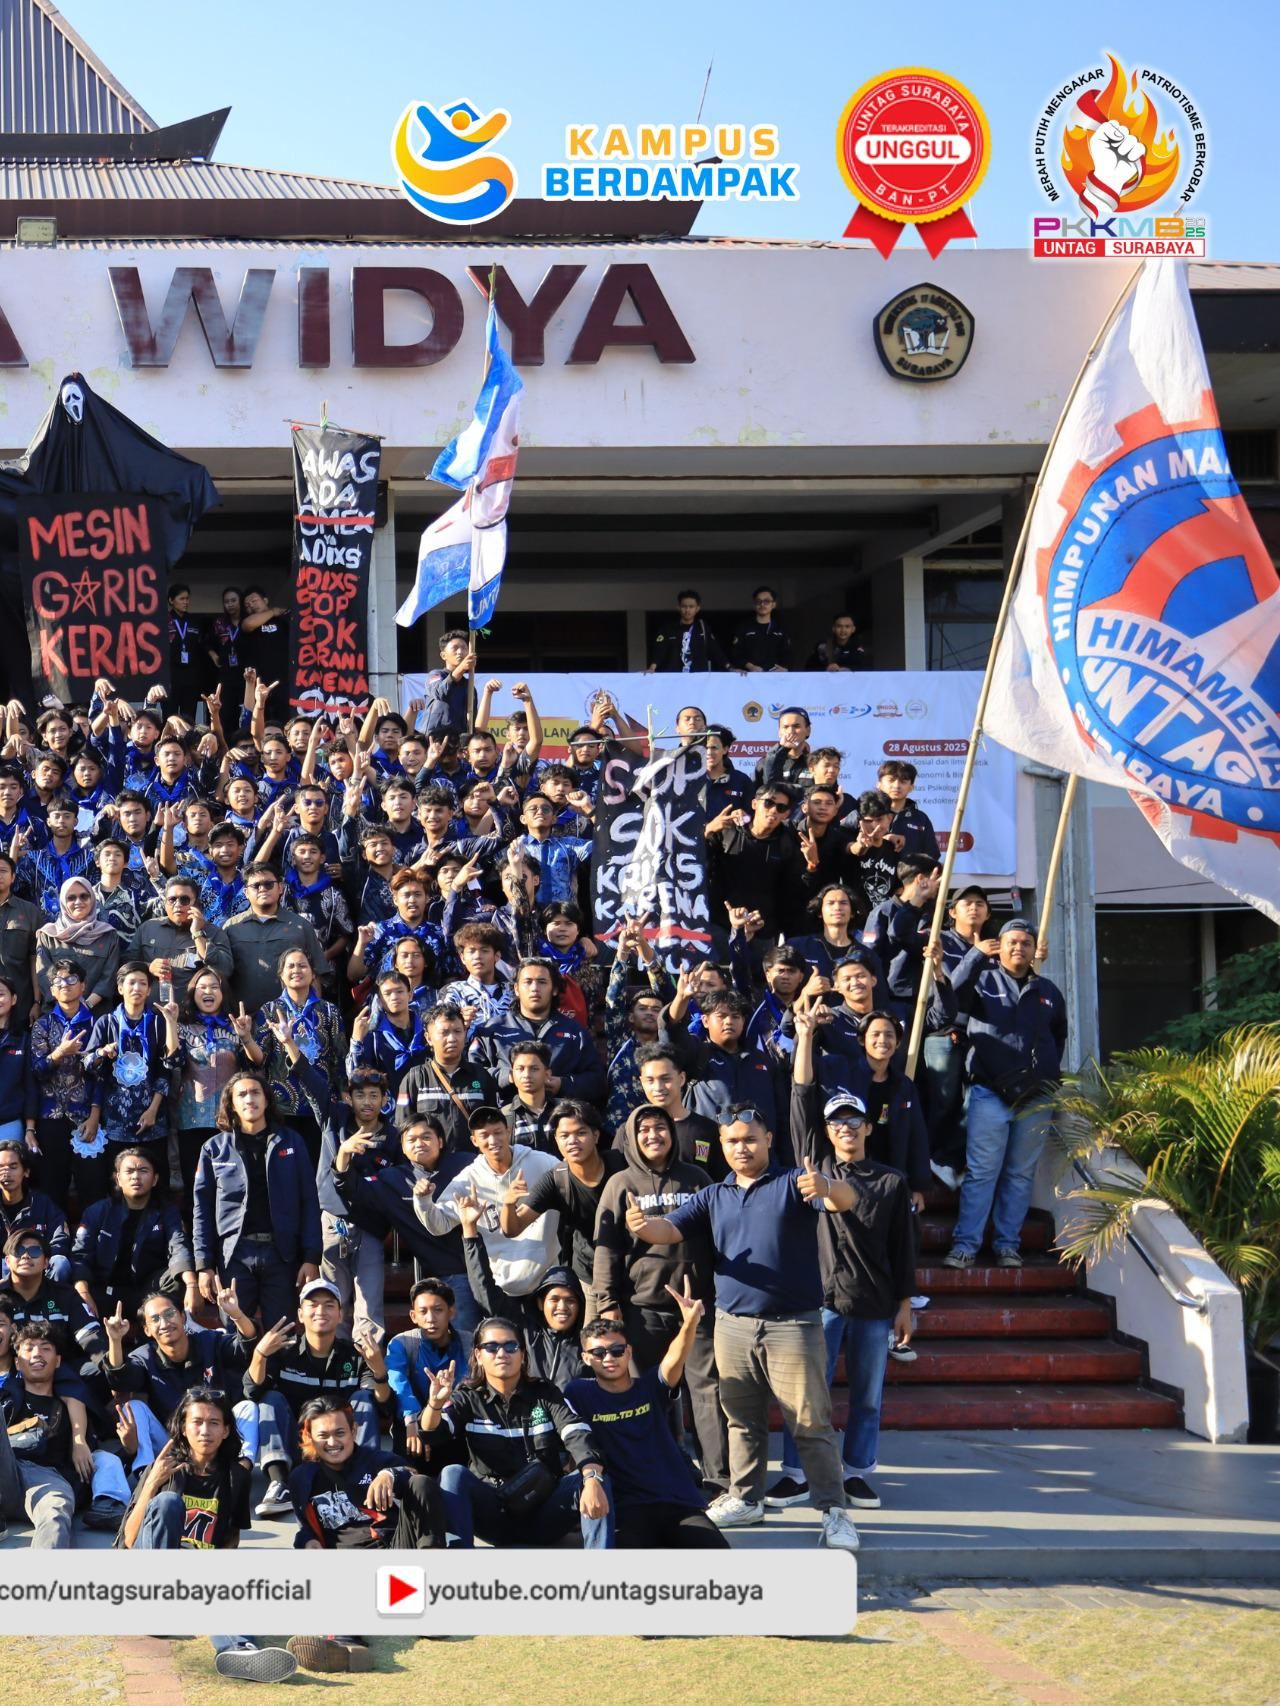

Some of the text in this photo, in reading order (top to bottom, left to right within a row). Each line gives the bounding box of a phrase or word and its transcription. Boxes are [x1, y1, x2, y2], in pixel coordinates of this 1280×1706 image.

[107, 262, 697, 369] WIDYA
[301, 448, 380, 484] AWAS
[27, 504, 152, 561] MESIN
[1053, 447, 1232, 642] HIMPUNAN MA
[38, 621, 163, 681] KERAS
[888, 742, 967, 754] 28 Agustus 2025
[1082, 657, 1256, 785] UNTAG
[916, 771, 944, 779] konomi
